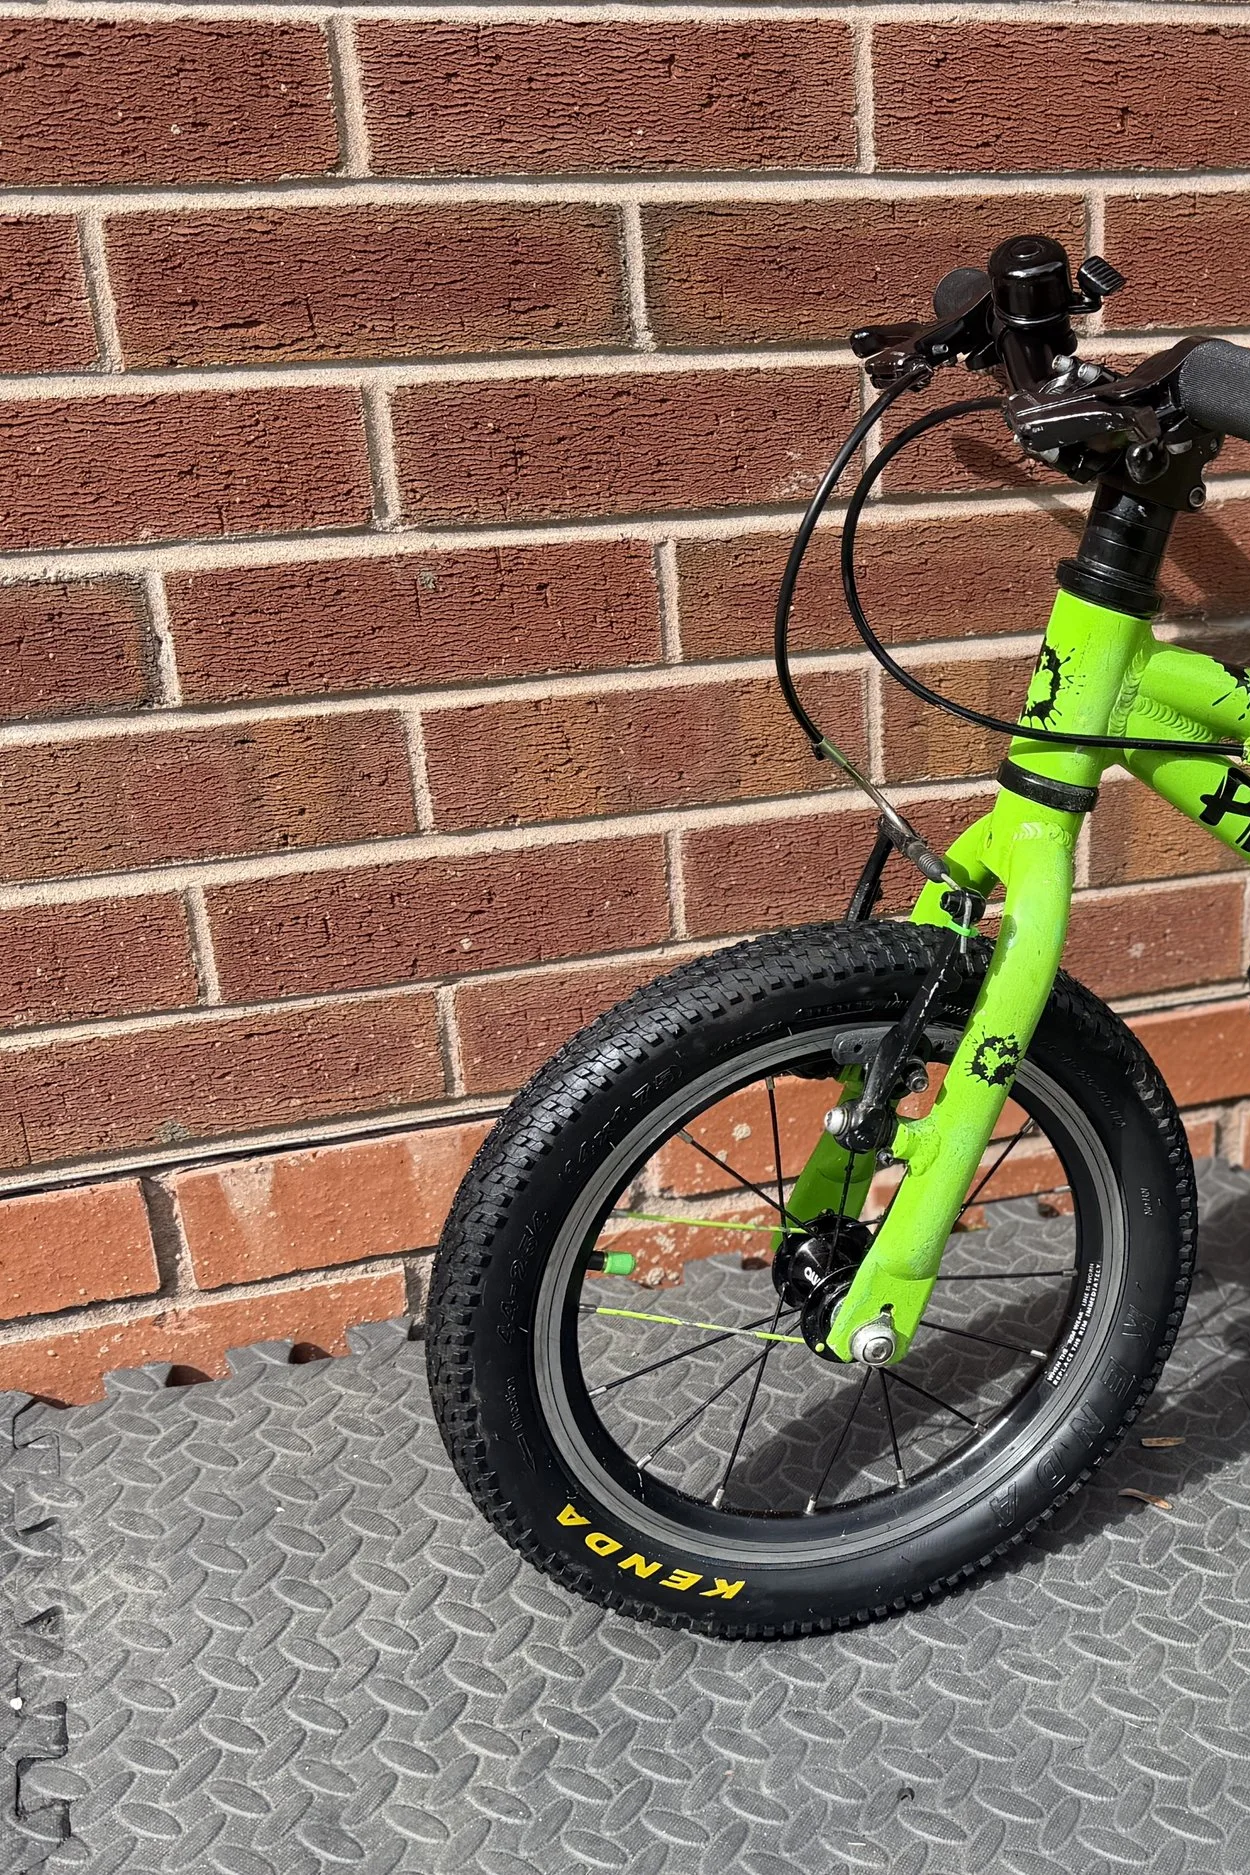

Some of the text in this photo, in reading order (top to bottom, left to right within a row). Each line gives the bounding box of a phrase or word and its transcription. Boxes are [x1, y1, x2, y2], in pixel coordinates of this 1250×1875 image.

[1052, 1263, 1102, 1386] REPLACE THE RIM IMMEDIATELY
[556, 1503, 746, 1600] KENDA
